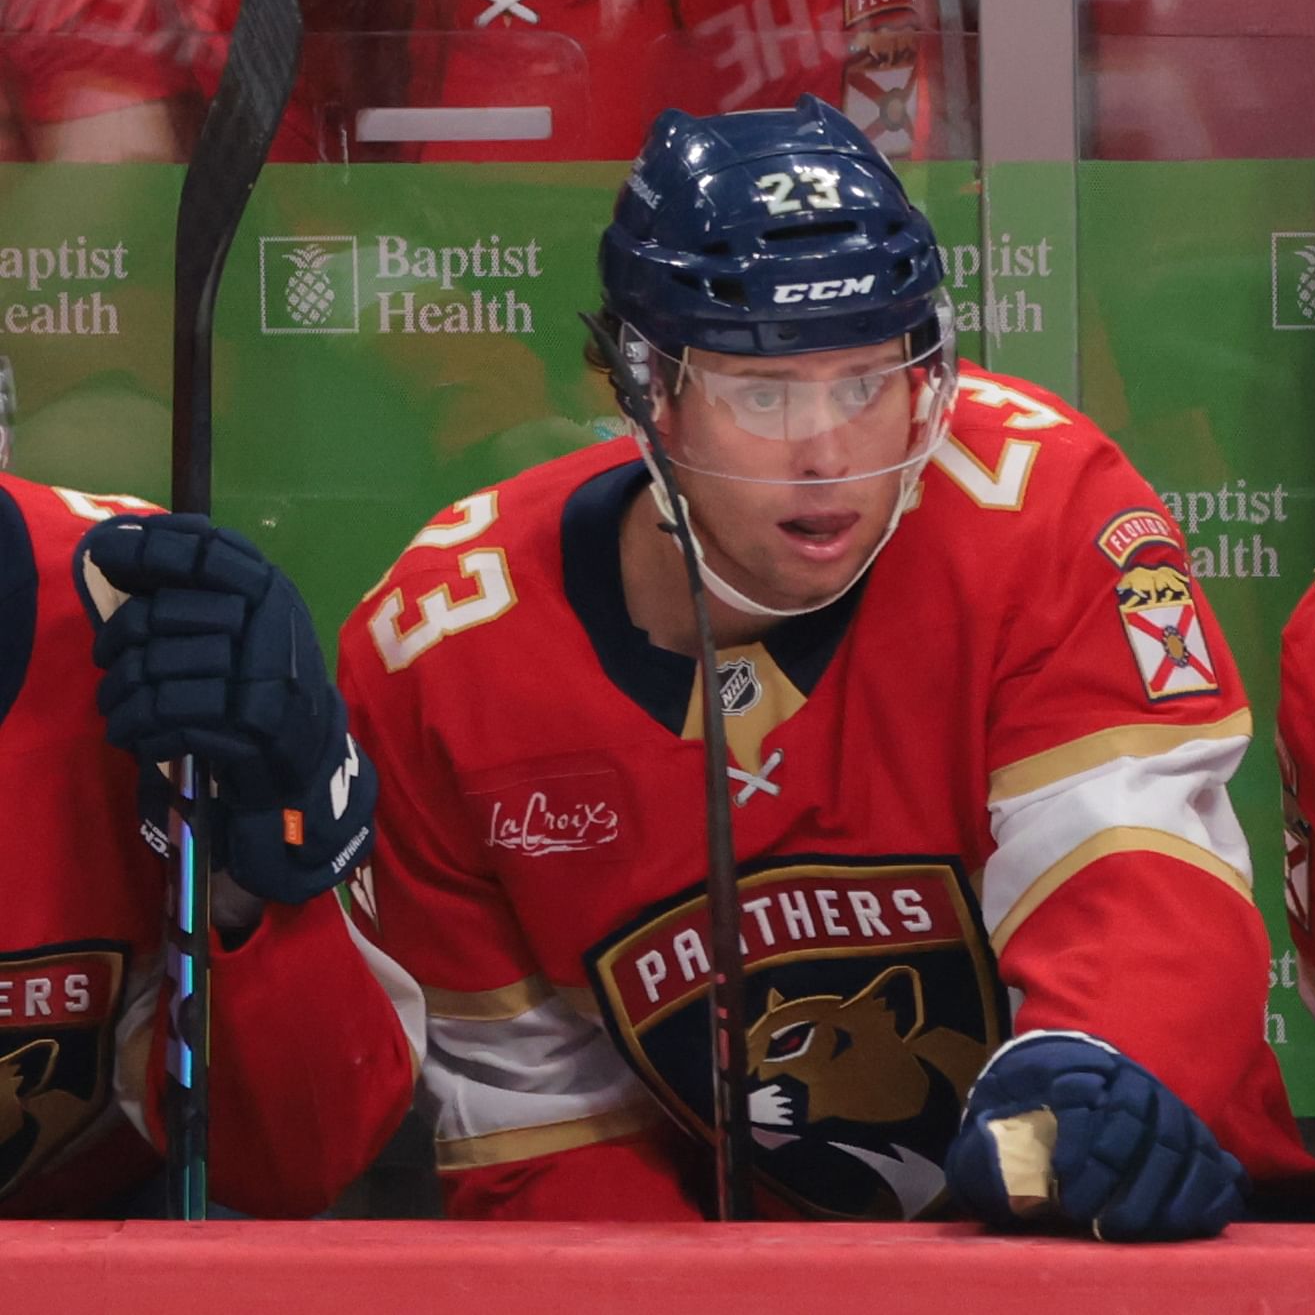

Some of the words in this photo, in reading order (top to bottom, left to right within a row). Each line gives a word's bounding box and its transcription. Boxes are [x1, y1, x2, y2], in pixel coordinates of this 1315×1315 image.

[755, 166, 843, 216] 23
[376, 236, 544, 289] Baptist
[376, 290, 535, 336] Health
[773, 275, 876, 305] CCM
[720, 671, 748, 707] NHL
[487, 791, 619, 855] LaCroix
[635, 888, 933, 1003] PATHERS
